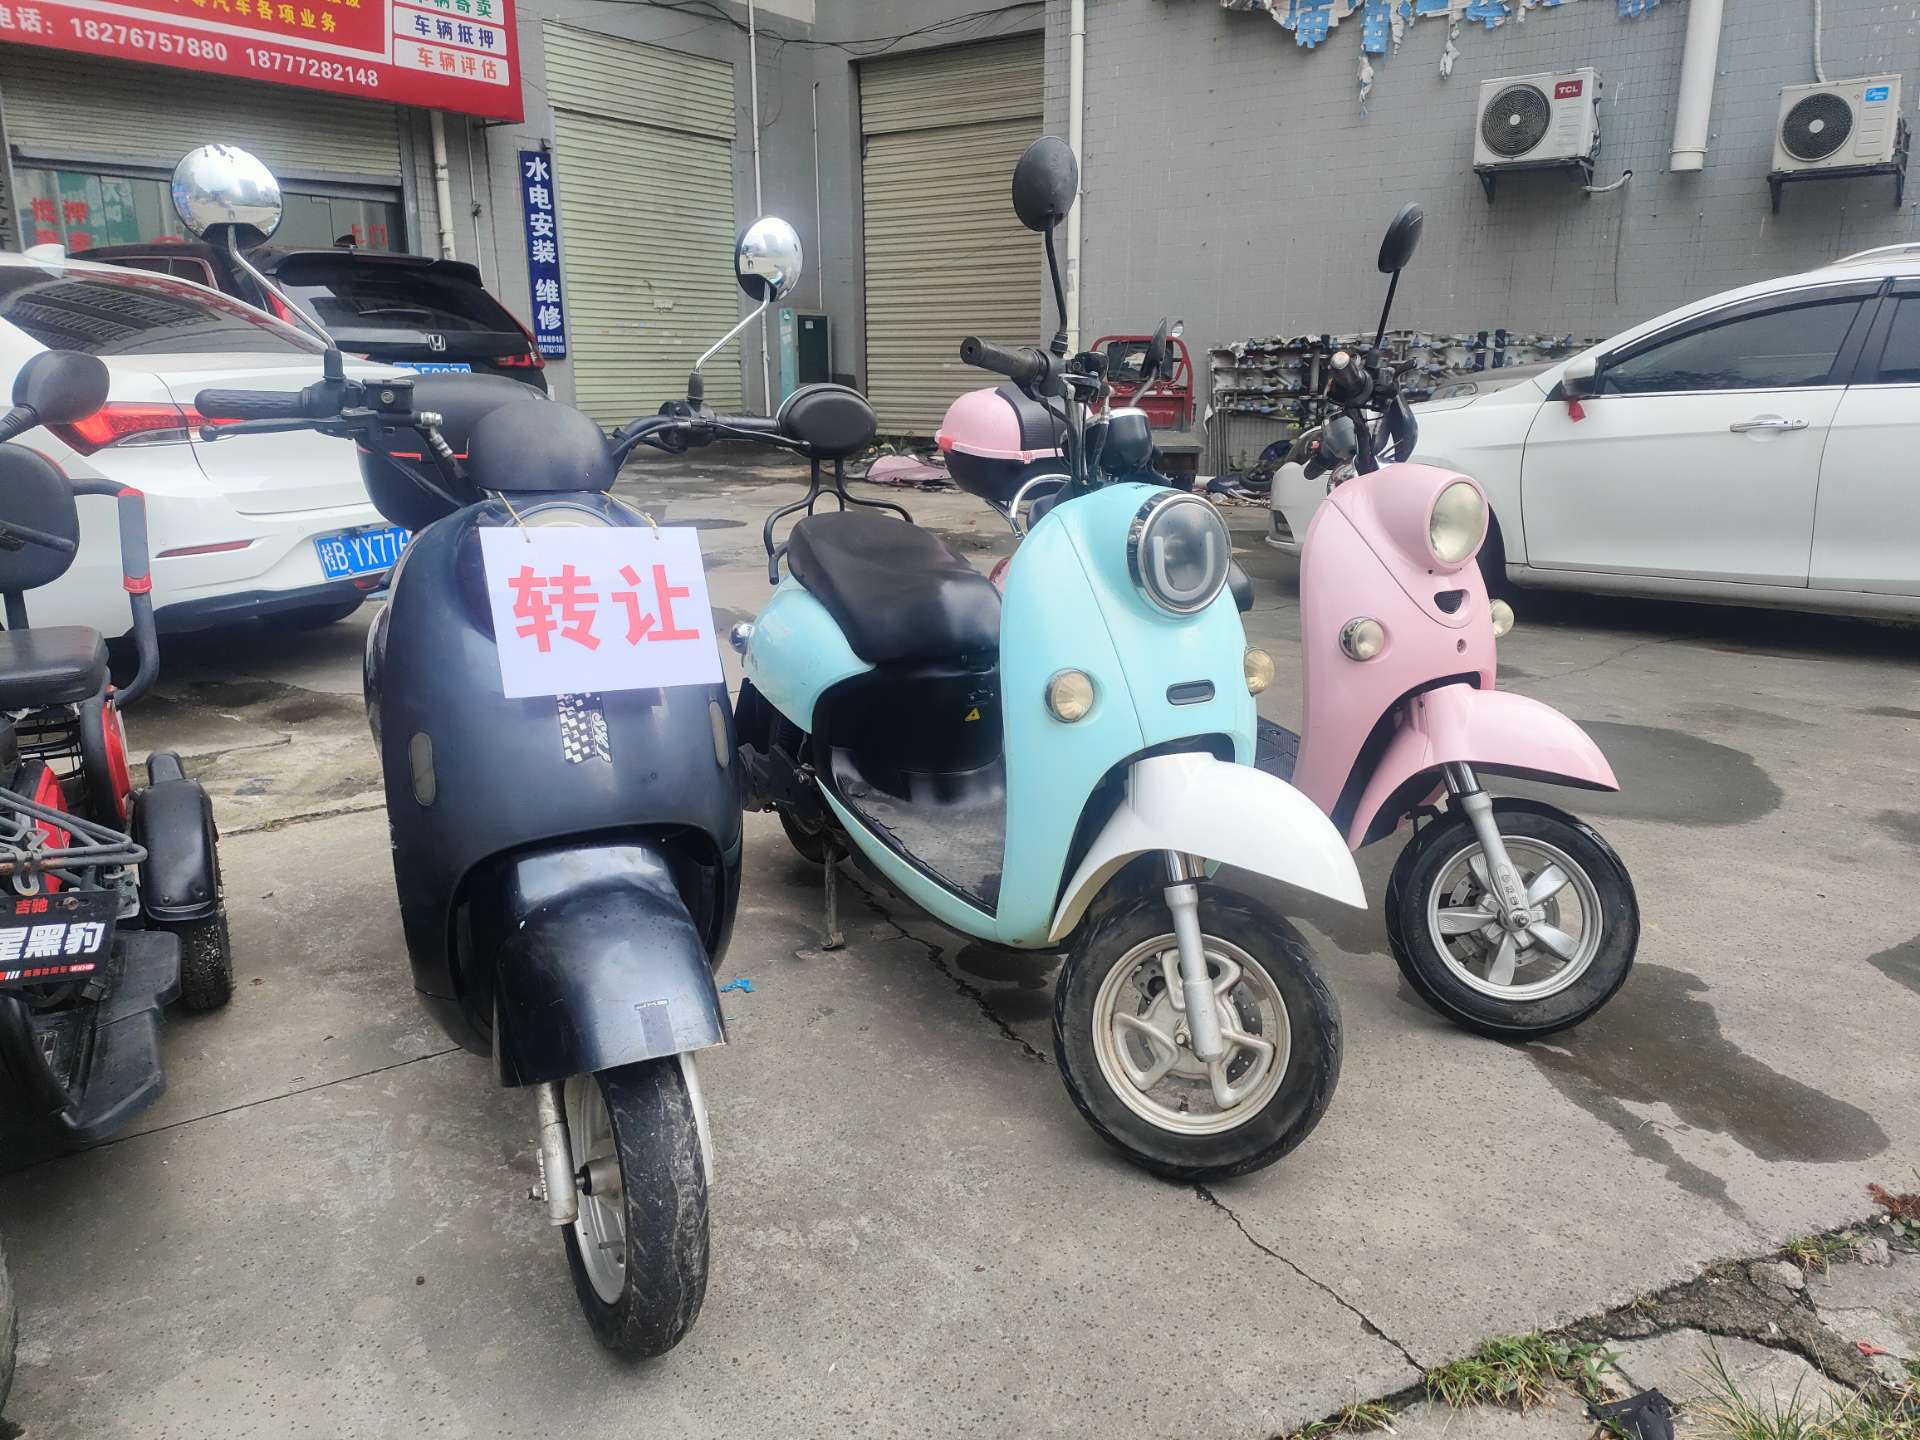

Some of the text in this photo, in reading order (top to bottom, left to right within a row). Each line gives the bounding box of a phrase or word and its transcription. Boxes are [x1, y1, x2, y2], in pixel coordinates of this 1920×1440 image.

[70, 17, 228, 62] 18276757880
[245, 48, 378, 87] 18777282148
[414, 14, 494, 48] 车辆抵押
[417, 47, 497, 79] 车辆评估
[1558, 86, 1579, 94] TCL
[525, 156, 556, 265] 水电安装
[535, 278, 562, 330] 维修
[508, 564, 700, 652] 转让
